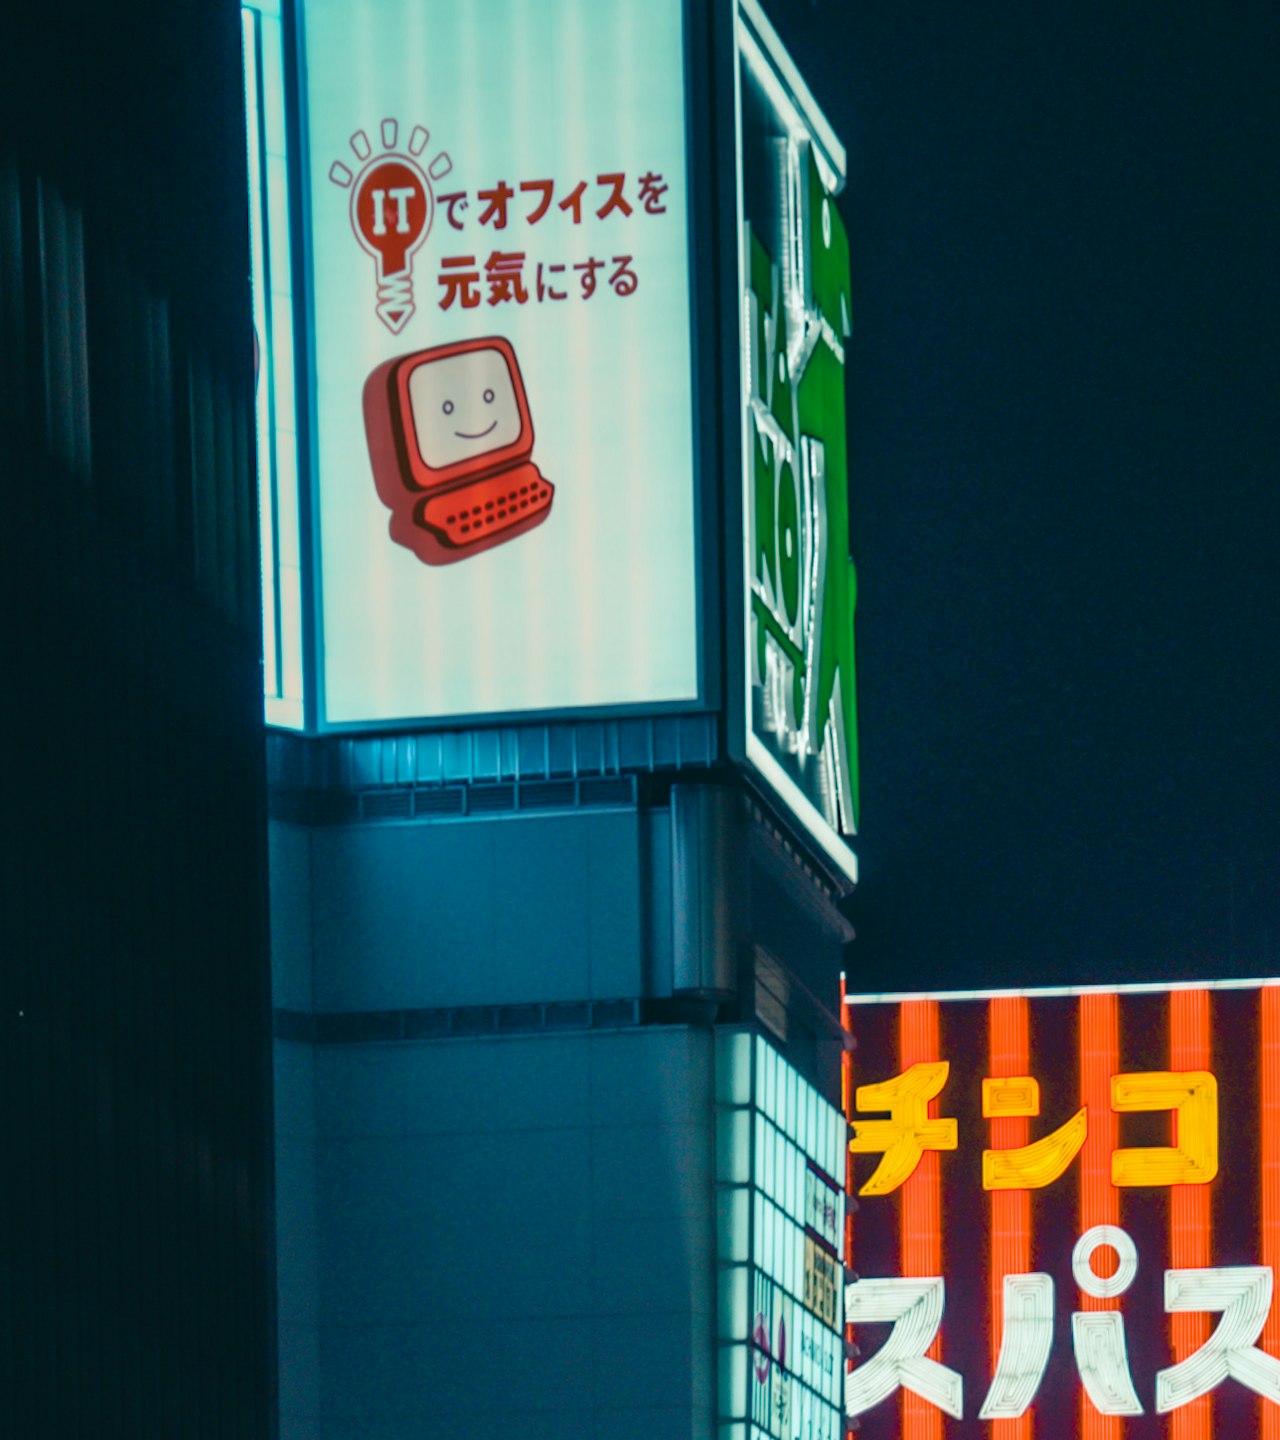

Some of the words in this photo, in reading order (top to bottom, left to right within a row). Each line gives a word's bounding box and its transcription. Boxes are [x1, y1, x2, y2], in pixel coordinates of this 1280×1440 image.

[371, 188, 415, 236] IT
[436, 170, 669, 232] でオフィスを
[437, 250, 640, 311] 元気にする
[849, 1060, 1218, 1196] チンコ
